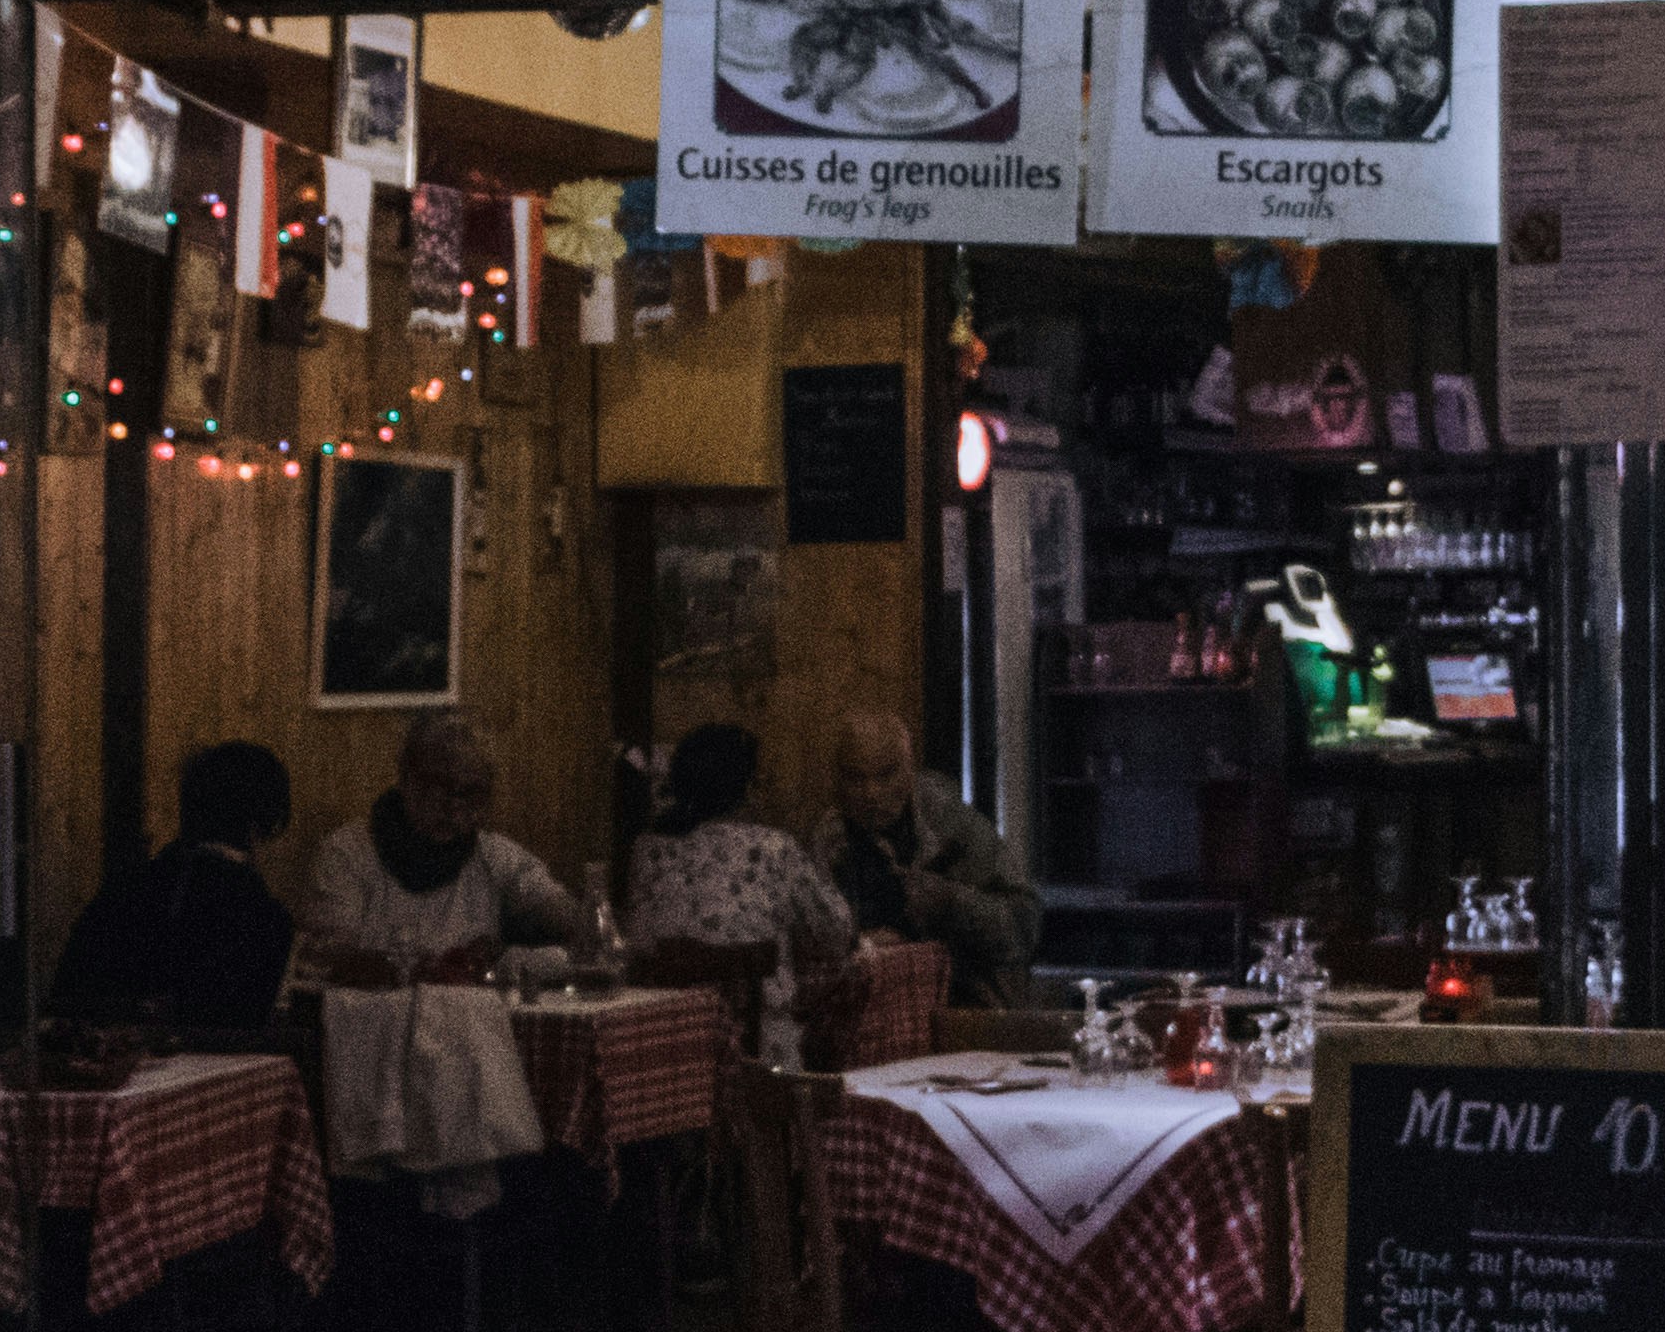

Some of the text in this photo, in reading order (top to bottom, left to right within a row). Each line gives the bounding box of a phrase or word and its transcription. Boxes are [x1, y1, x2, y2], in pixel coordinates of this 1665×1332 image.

[677, 148, 1062, 192] Cuisses de grenouilles
[1217, 151, 1383, 192] Escargots
[805, 194, 931, 225] Frog's legs
[1261, 195, 1334, 220] Snails
[1395, 1088, 1564, 1155] MENU
